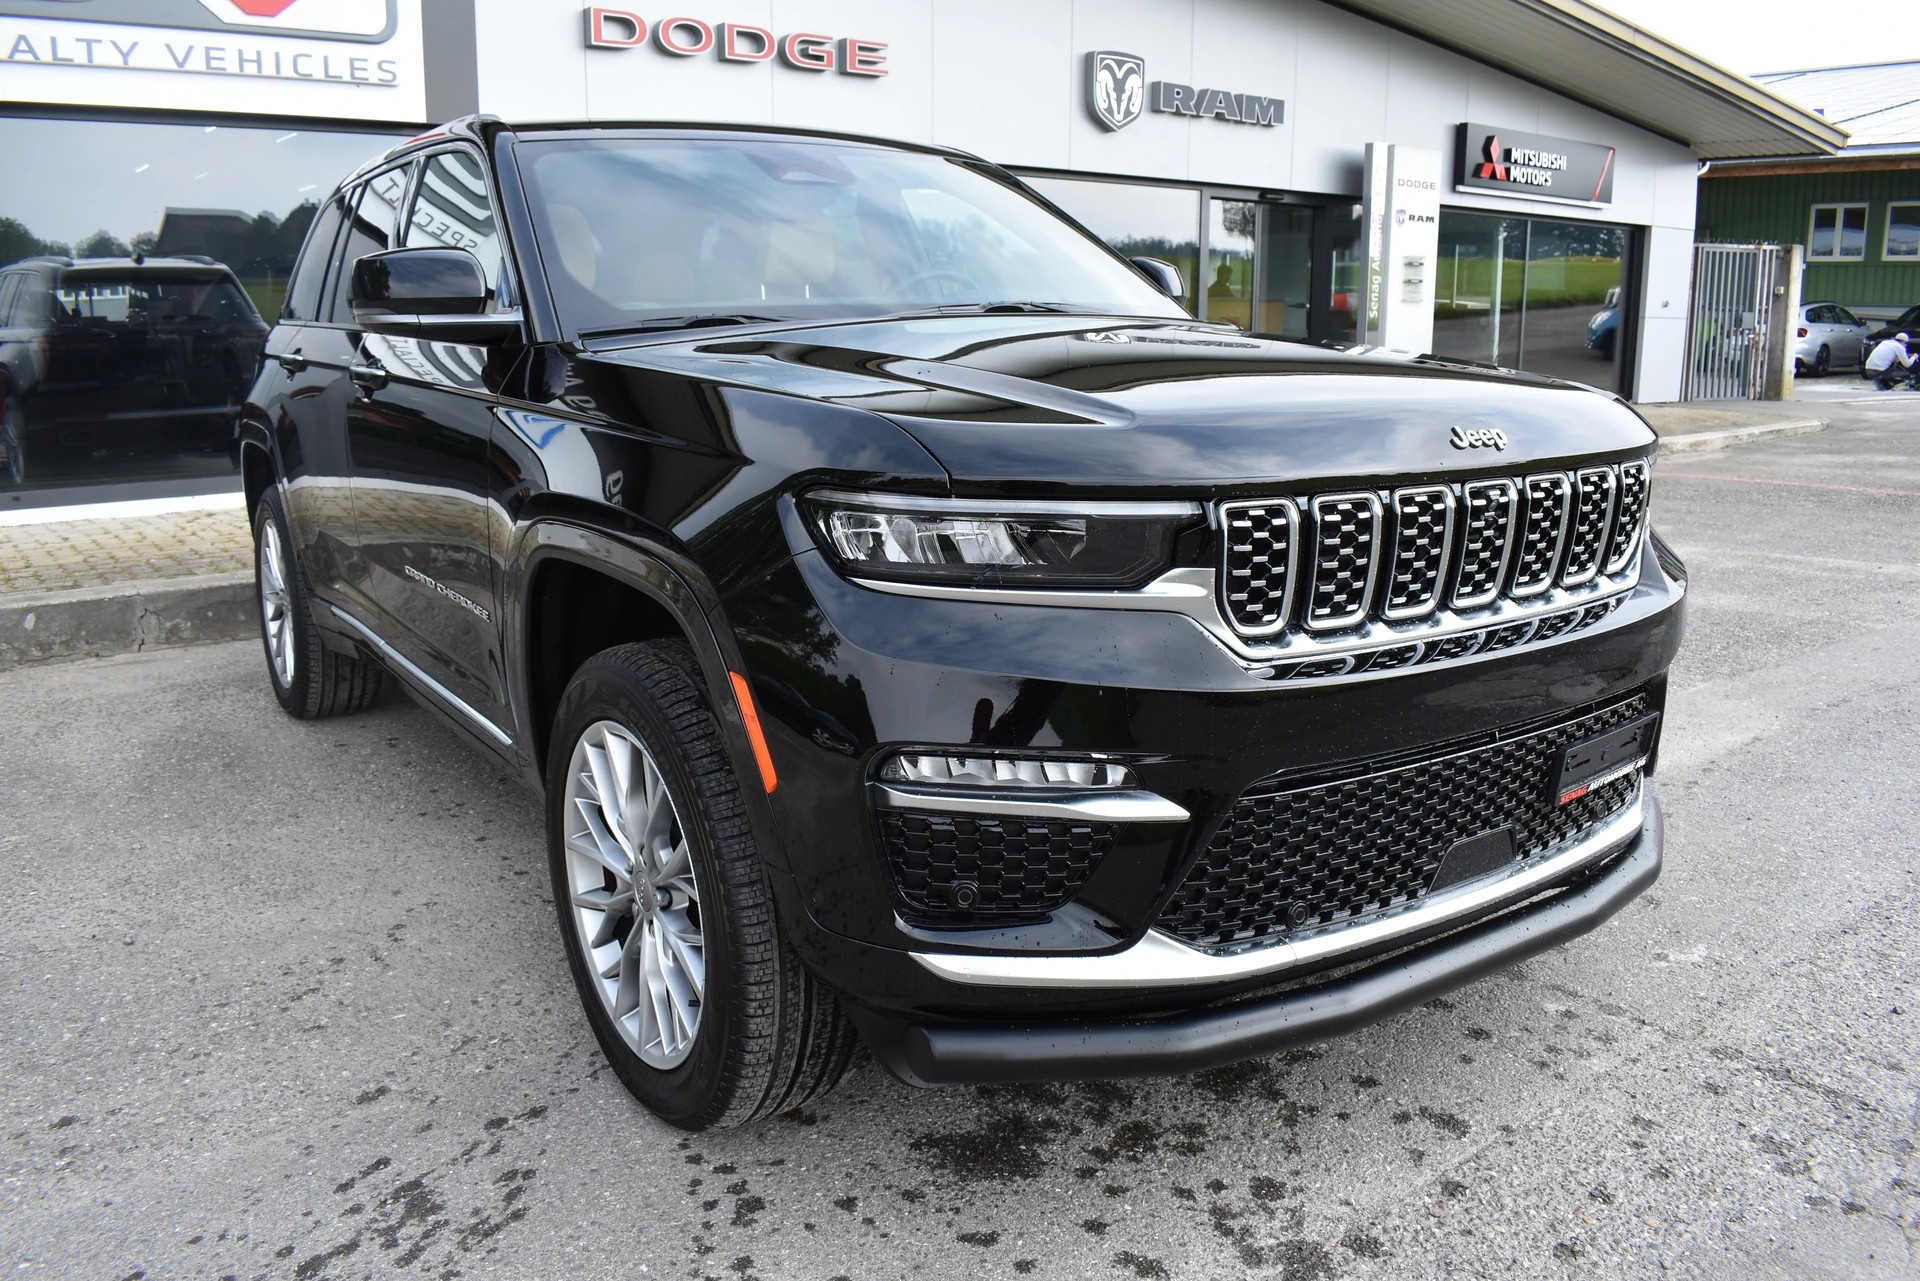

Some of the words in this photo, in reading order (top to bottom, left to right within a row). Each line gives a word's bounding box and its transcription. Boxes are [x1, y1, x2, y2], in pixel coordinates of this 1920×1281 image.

[584, 6, 888, 77] DODGE
[164, 42, 398, 83] VEHICLES
[1152, 80, 1285, 127] RAM
[1510, 147, 1567, 171] MITSUBISHI
[1397, 178, 1437, 190] DODGE
[1509, 166, 1552, 187] MOTORS
[1408, 214, 1435, 223] RAM
[1369, 275, 1382, 318] Senag
[1449, 425, 1508, 452] Jeep
[436, 582, 491, 622] CHEROKEE
[1559, 786, 1588, 805] SENAG
